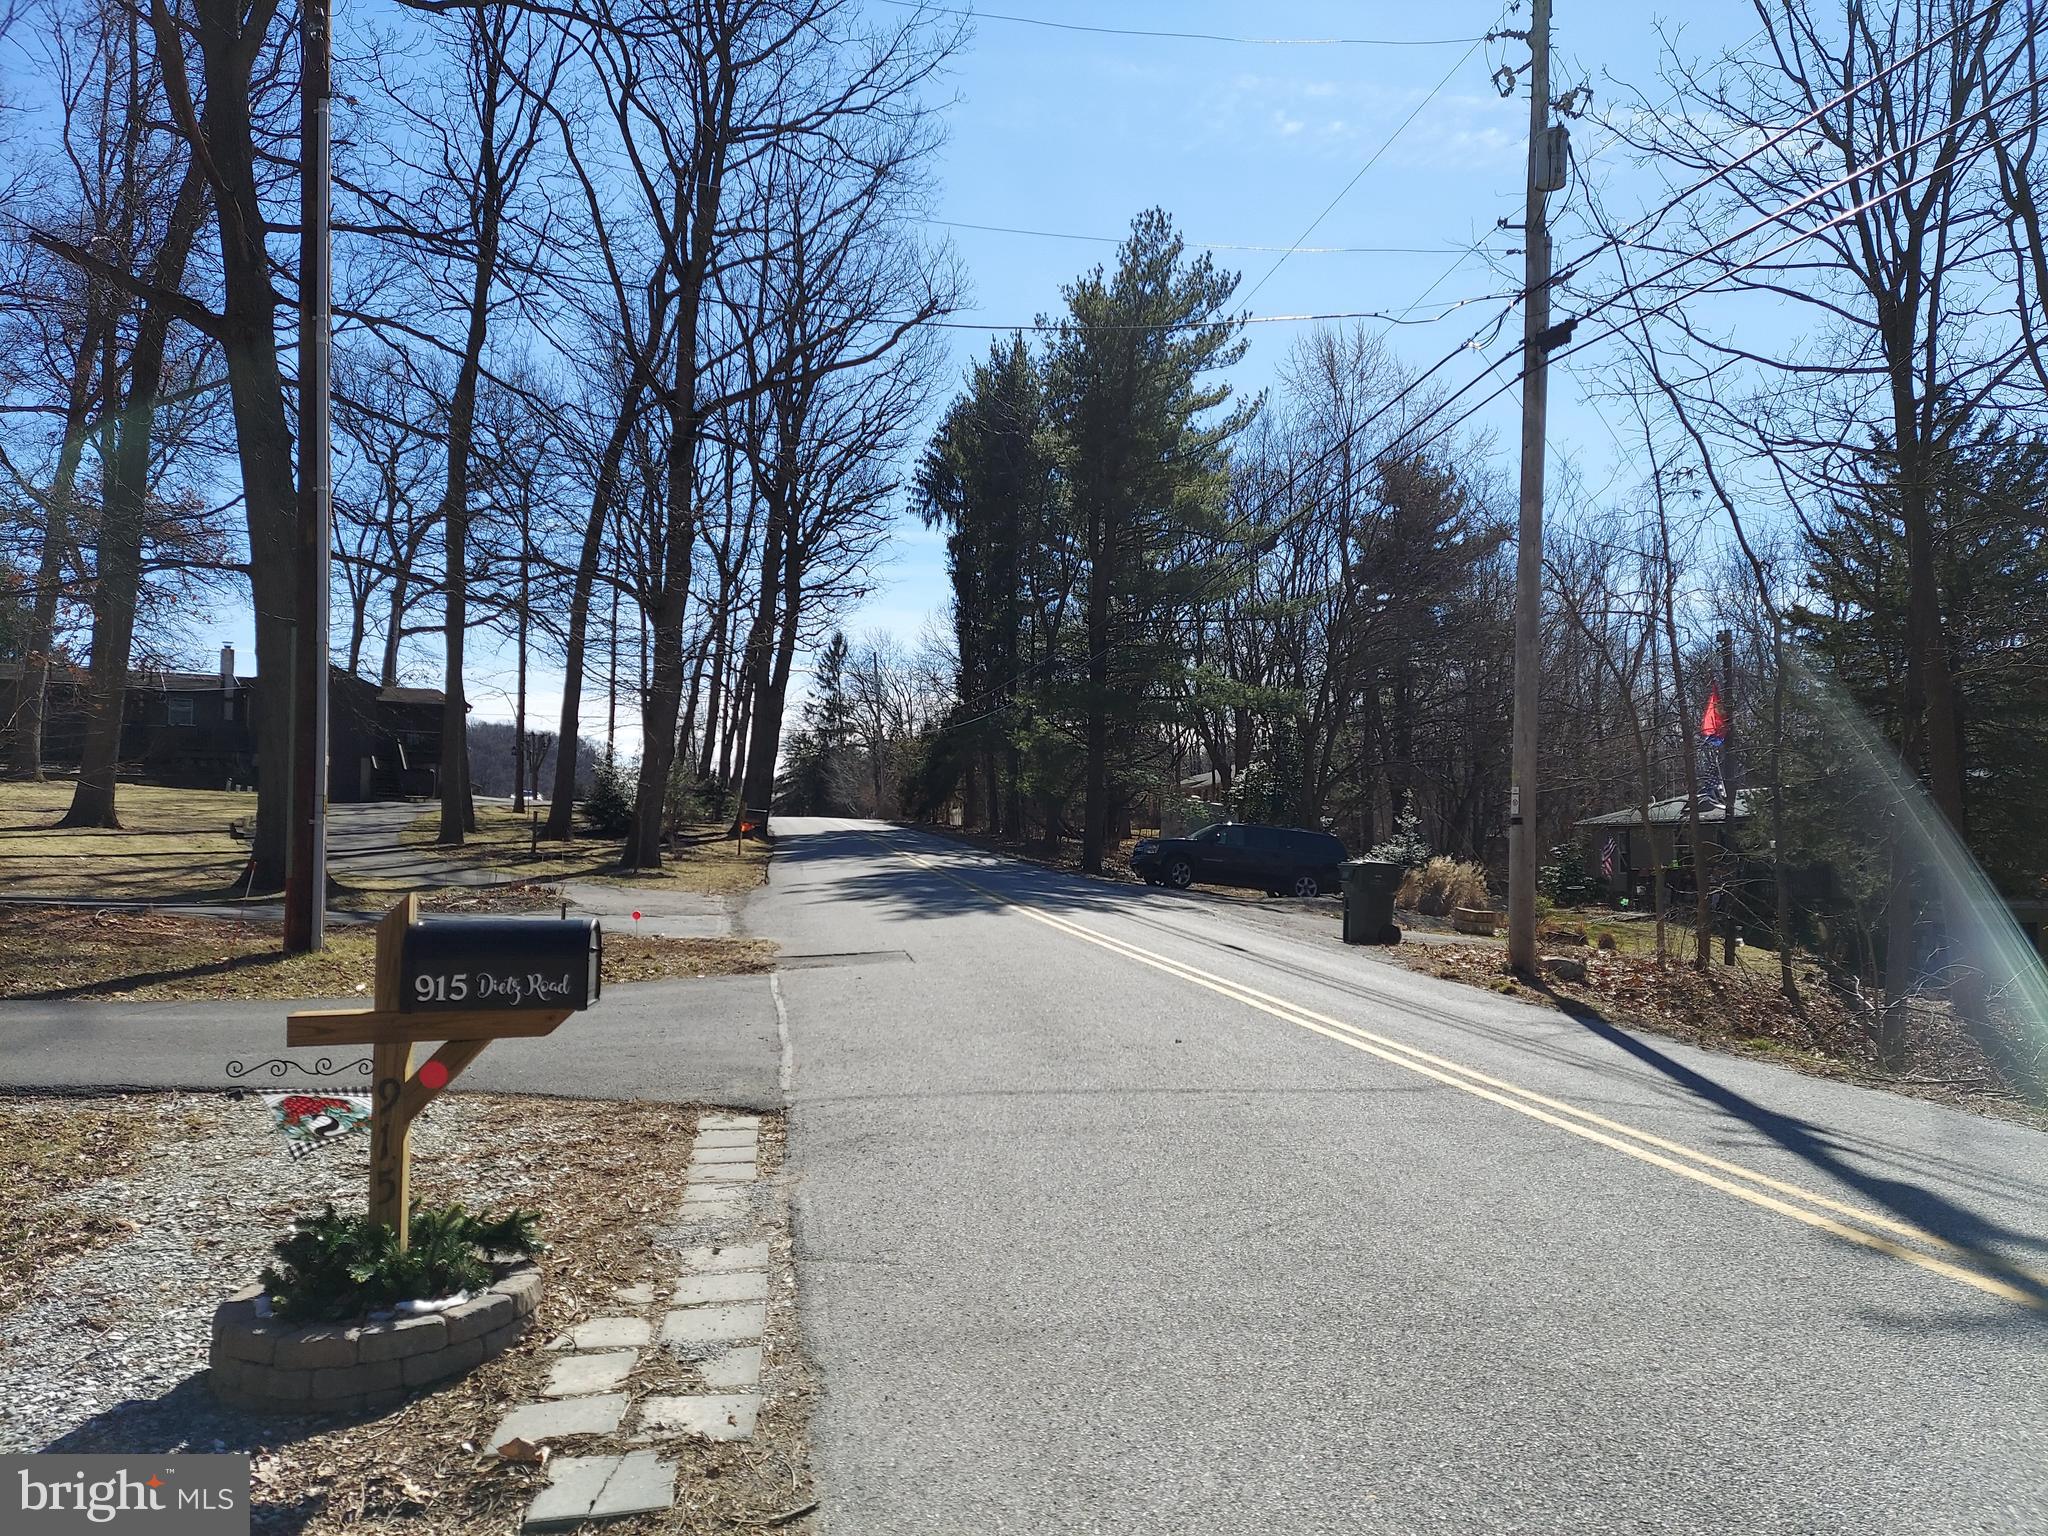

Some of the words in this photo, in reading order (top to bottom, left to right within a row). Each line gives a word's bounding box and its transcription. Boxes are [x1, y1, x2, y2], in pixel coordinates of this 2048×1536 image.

[415, 973, 468, 1002] 915
[475, 972, 521, 1006] Dietz
[524, 973, 570, 1001] Road
